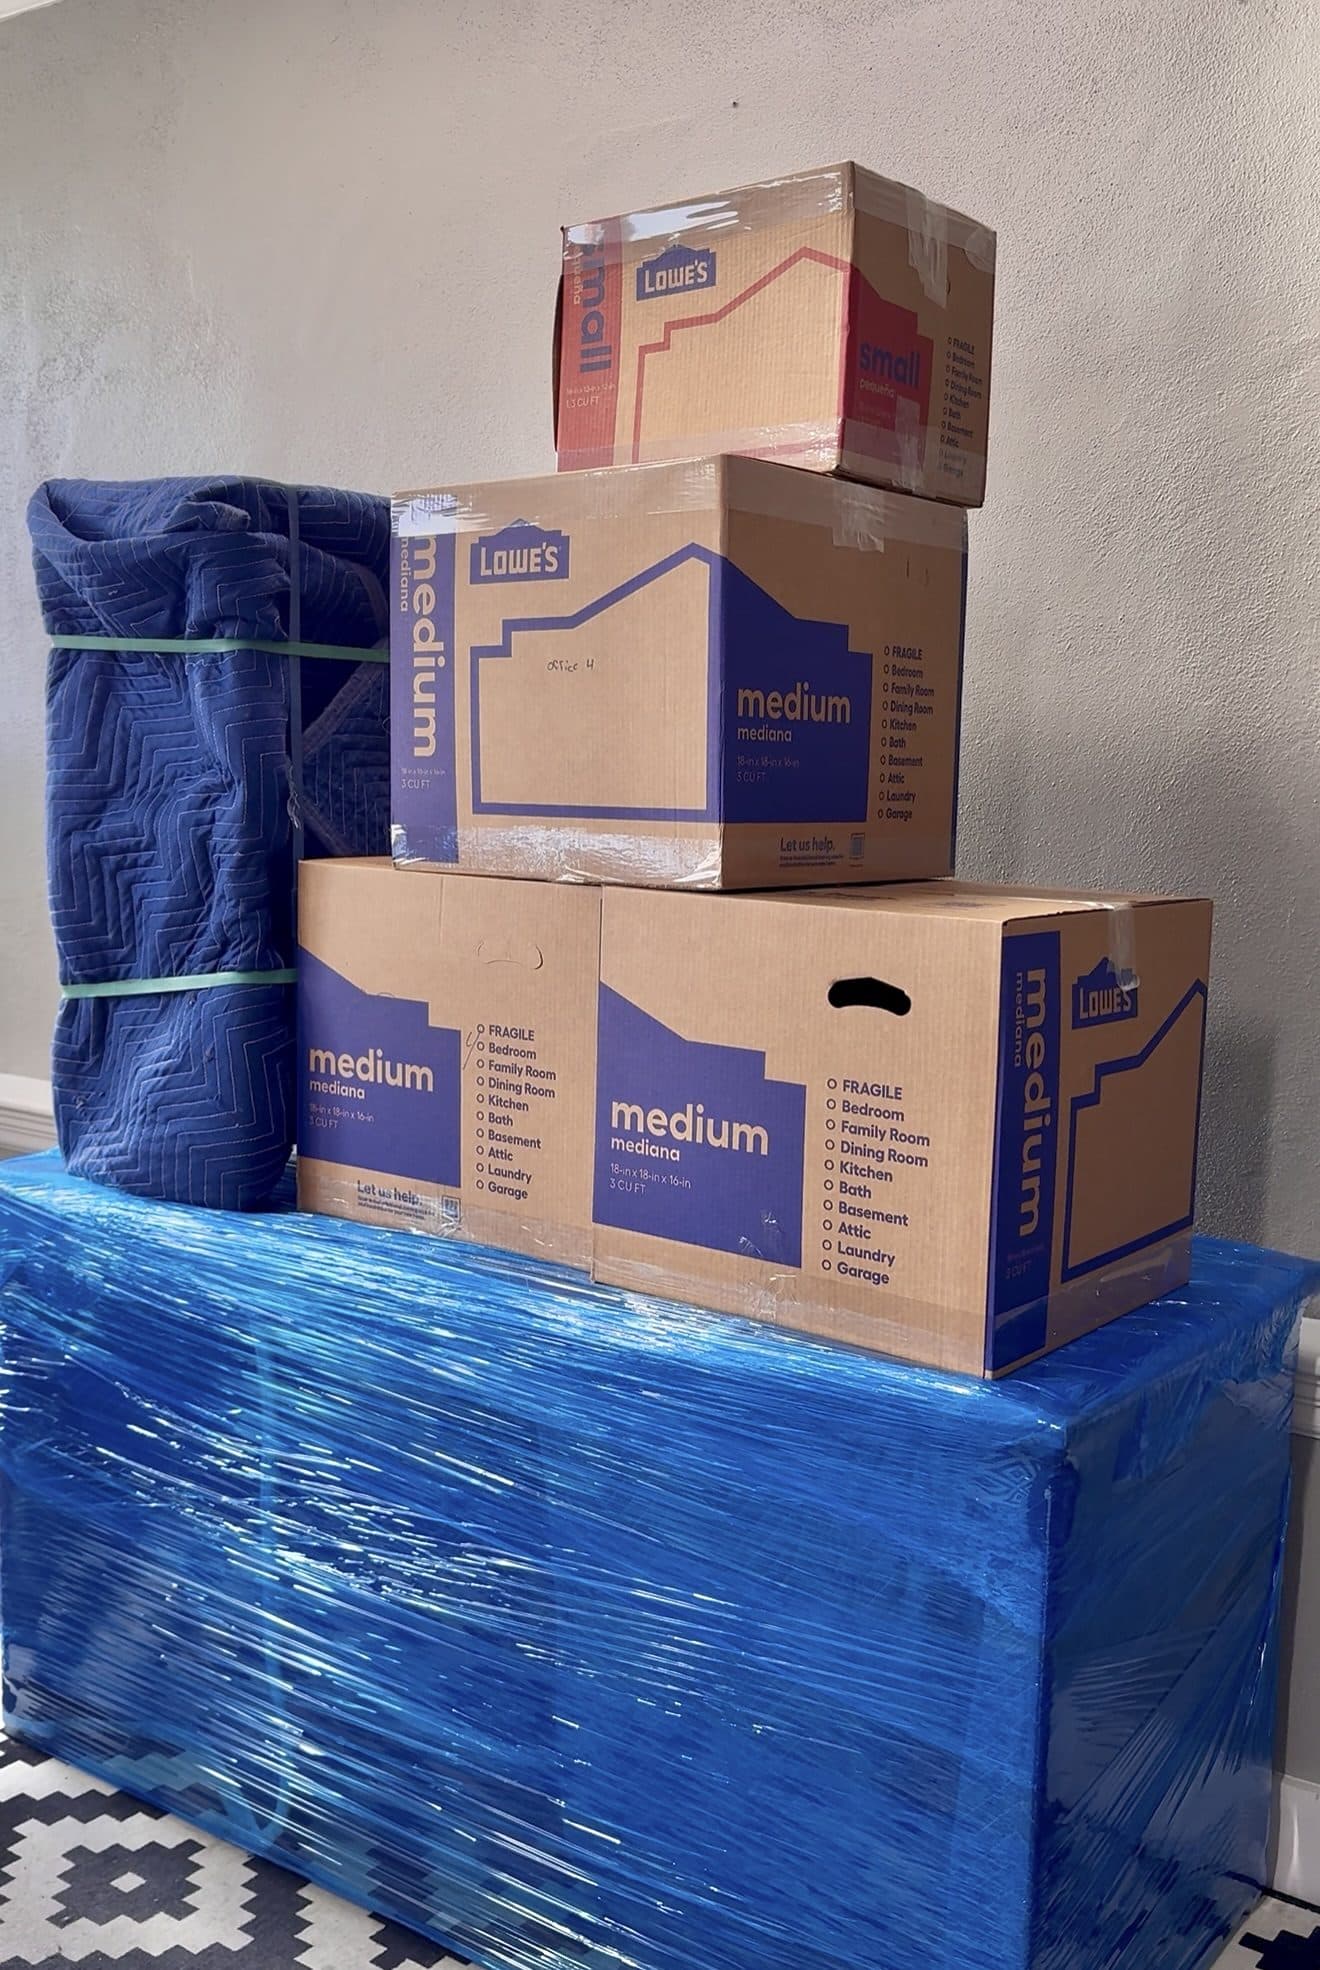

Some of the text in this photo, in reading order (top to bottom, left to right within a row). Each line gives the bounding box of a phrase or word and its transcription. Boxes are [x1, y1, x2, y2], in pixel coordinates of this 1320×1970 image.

[644, 260, 708, 293] LOWE'S
[953, 338, 975, 355] FRAGILE
[859, 341, 921, 389] small
[480, 541, 559, 577] LOWE'S
[400, 536, 412, 612] mediana
[412, 535, 446, 758] medium
[892, 646, 922, 660] FRAGILE
[892, 665, 923, 678] Bedroom
[891, 682, 935, 697] Family Room
[737, 681, 851, 724] medium
[890, 701, 934, 716] Dining Room
[737, 725, 792, 742] mediana
[889, 719, 917, 732] Kitchen
[888, 737, 906, 749] Bath
[888, 755, 923, 767] Basement
[407, 779, 420, 789] CU
[420, 779, 431, 789] FT
[743, 771, 756, 783] CU
[756, 772, 767, 783] FT
[887, 772, 905, 784] Attic
[886, 791, 916, 805] Laundry
[885, 808, 912, 822] Garage
[780, 837, 797, 852] Let
[799, 840, 810, 851] us
[1079, 986, 1132, 1020] LOWES
[1014, 972, 1025, 1068] mediana
[489, 1025, 535, 1041] FRAGILE
[488, 1042, 537, 1060] Bedroom
[309, 1048, 434, 1092] medium
[488, 1060, 557, 1081] Family Room
[309, 1079, 365, 1099] mediana
[488, 1077, 556, 1098] Dining Room
[843, 1079, 903, 1100] FRAGILE
[488, 1095, 529, 1112] Kitchen
[842, 1100, 905, 1122] Bedroom
[1019, 968, 1051, 1236] medium
[315, 1117, 328, 1128] CU
[329, 1119, 338, 1128] FT
[488, 1112, 513, 1126] Bath
[611, 1101, 769, 1156] medium
[488, 1130, 542, 1149] Basement
[841, 1120, 930, 1147] Family Room
[487, 1147, 513, 1161] Attic
[611, 1137, 680, 1161] mediana
[840, 1140, 929, 1167] Dining Room
[488, 1164, 532, 1184] Laundry
[610, 1163, 631, 1177] 18-in
[639, 1169, 660, 1182] 18-in
[669, 1175, 692, 1189] 16-in
[839, 1161, 893, 1182] Kitchen
[357, 1180, 423, 1206] Let us help.
[488, 1181, 529, 1200] Garage
[609, 1178, 647, 1194] 3 CU FT
[839, 1181, 872, 1199] Bath
[838, 1201, 909, 1226] Basement
[838, 1221, 872, 1240] Attic
[837, 1241, 896, 1267] Laundry
[837, 1261, 890, 1285] Garage
